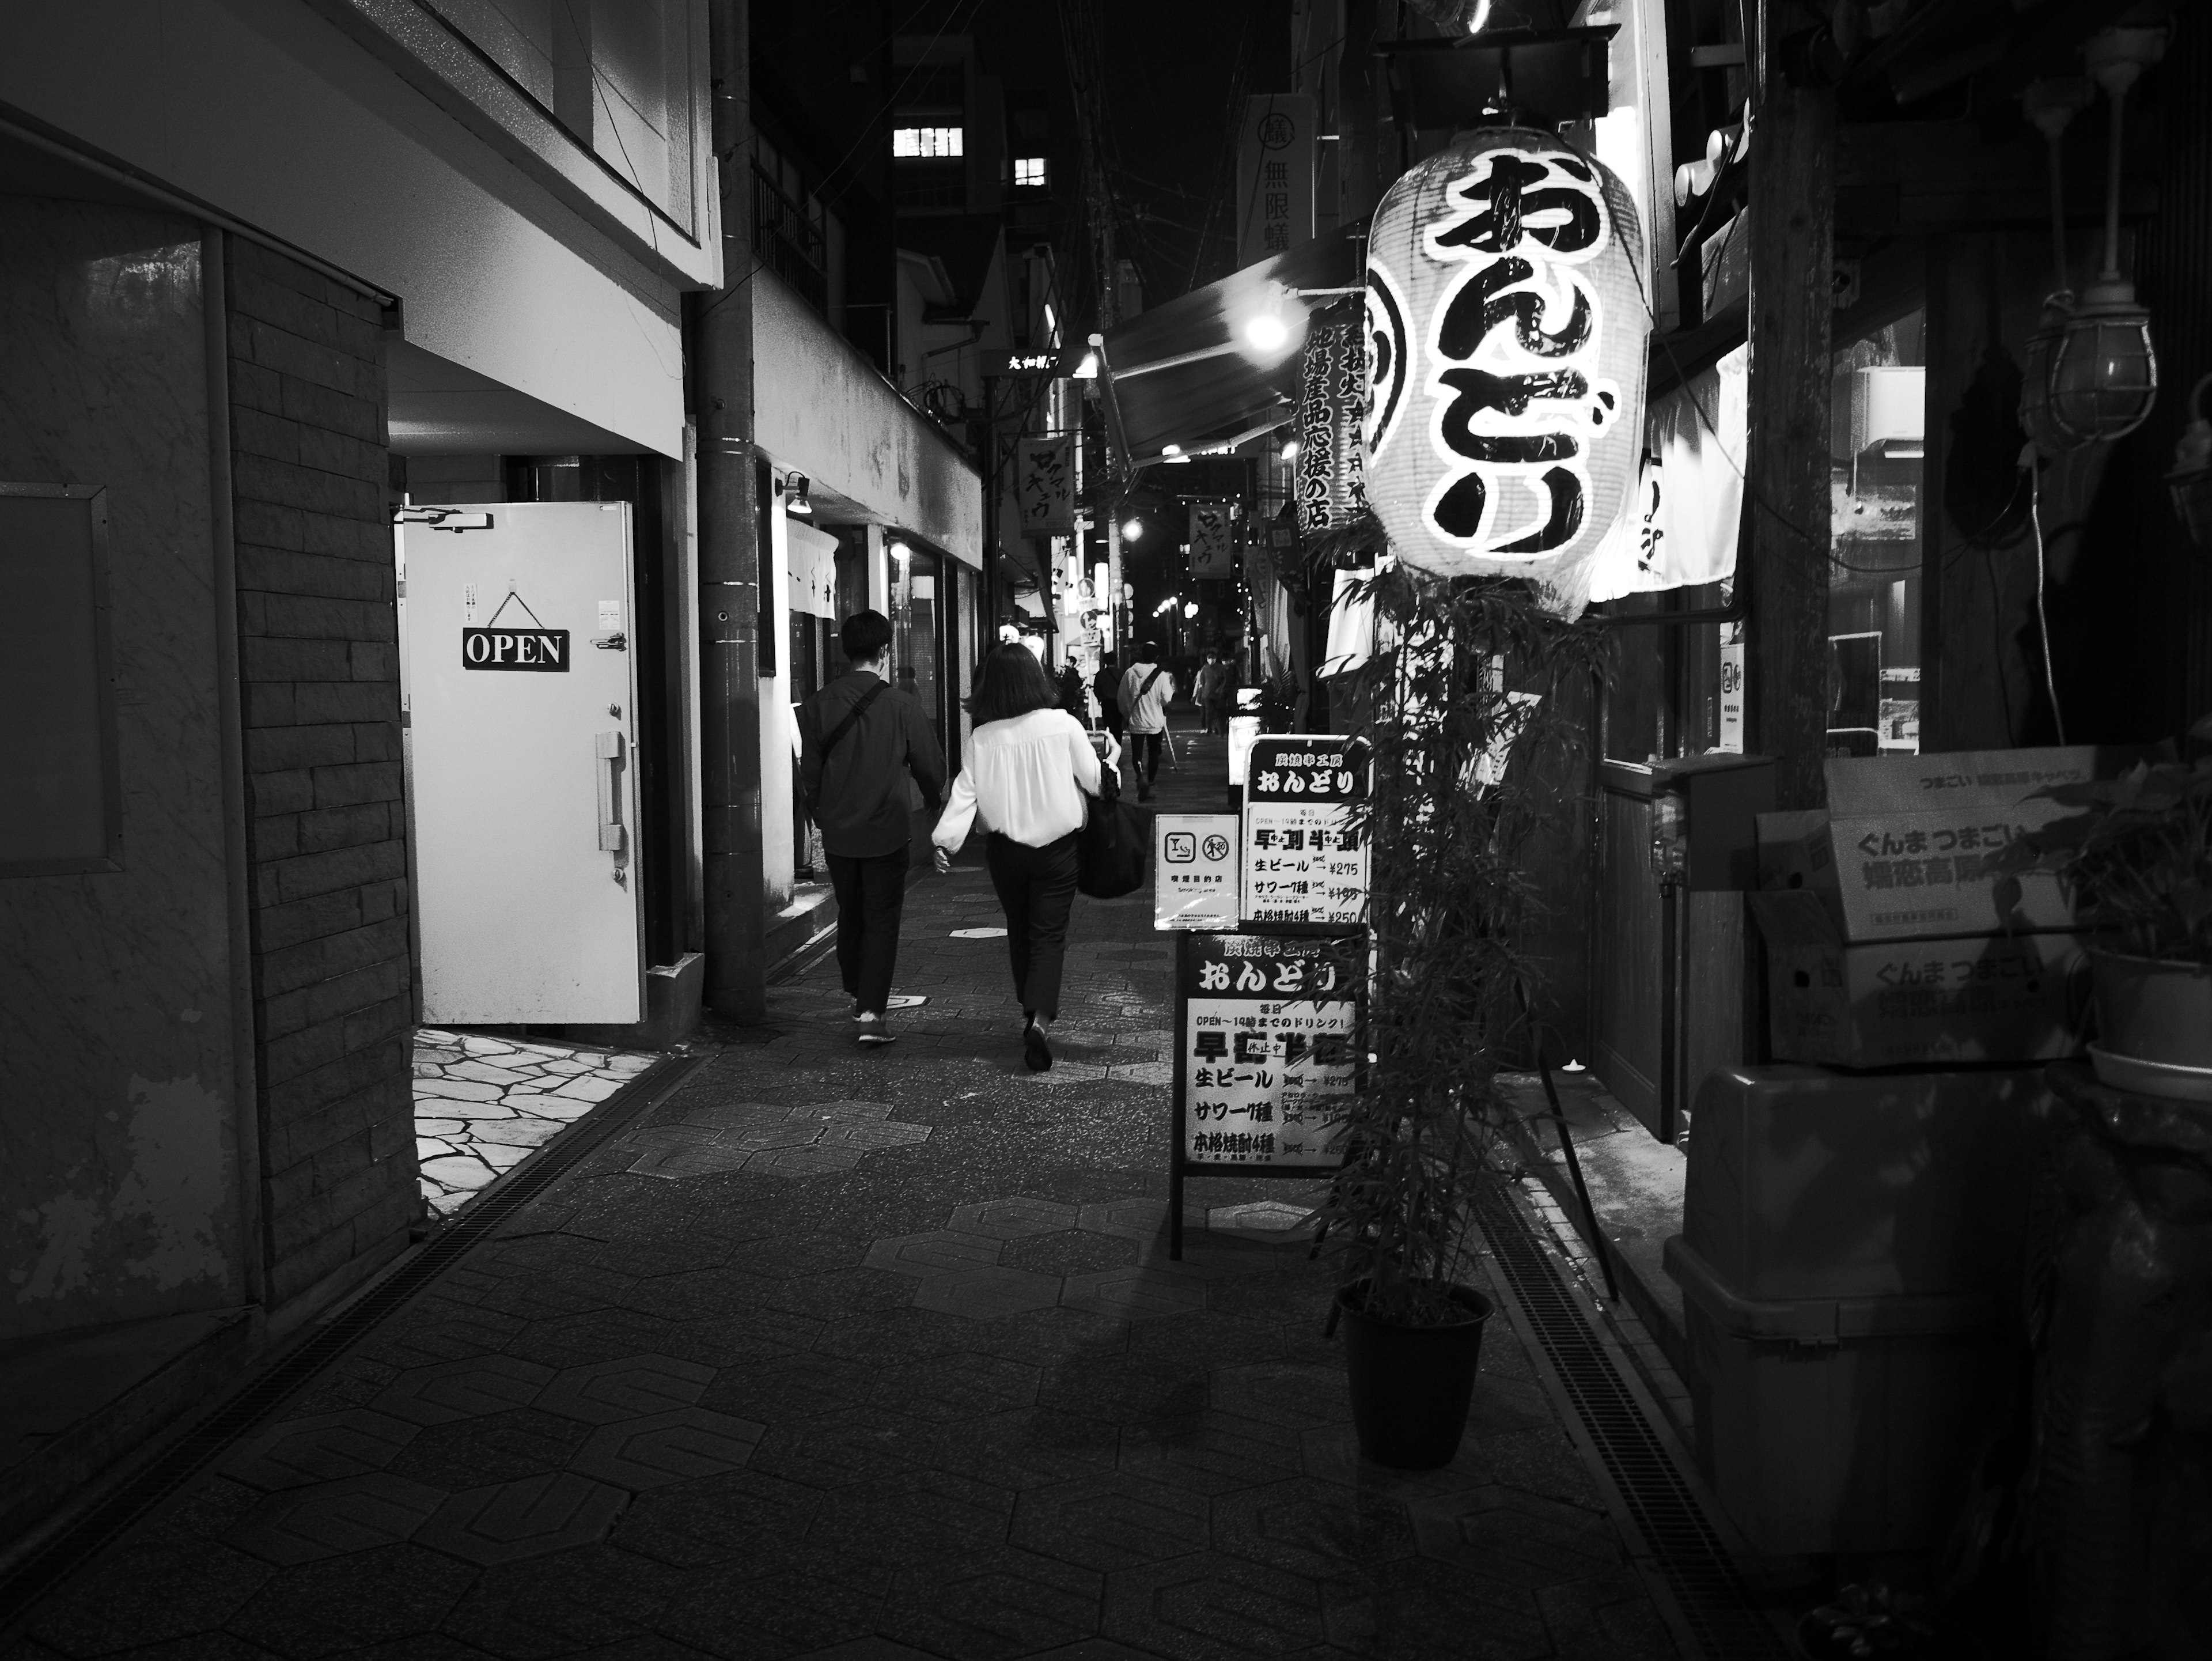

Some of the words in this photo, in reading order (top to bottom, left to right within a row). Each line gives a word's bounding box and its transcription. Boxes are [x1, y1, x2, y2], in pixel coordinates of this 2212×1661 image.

[1264, 160, 1290, 252] 無限蟻
[1431, 152, 1616, 555] おんどり
[1302, 326, 1335, 529] 地場産品応援の店
[466, 634, 562, 664] OPEN
[1257, 770, 1354, 794] おんどり
[1920, 775, 1973, 790] つまごい
[1271, 833, 1285, 843] 中止
[1325, 835, 1341, 844] 中止
[1858, 830, 1928, 857] ぐんま
[1933, 824, 2025, 852] つまごい
[1255, 858, 1309, 872] 生ビール
[1330, 862, 1358, 876] ¥275
[1171, 875, 1222, 883] 喫煙目的店
[1255, 880, 1308, 894] サワー7種
[1328, 911, 1357, 924] ¥250
[1199, 960, 1336, 992] おんどり
[1876, 960, 1946, 986] ぐんま
[1951, 956, 2045, 981] つまごい
[1260, 1004, 1281, 1015] 毎日
[1248, 1043, 1282, 1054] 休止中
[1195, 1067, 1274, 1089] 生ビール
[1195, 1101, 1273, 1122] サワー7種
[1194, 1131, 1275, 1153] 本格焼酎4種
